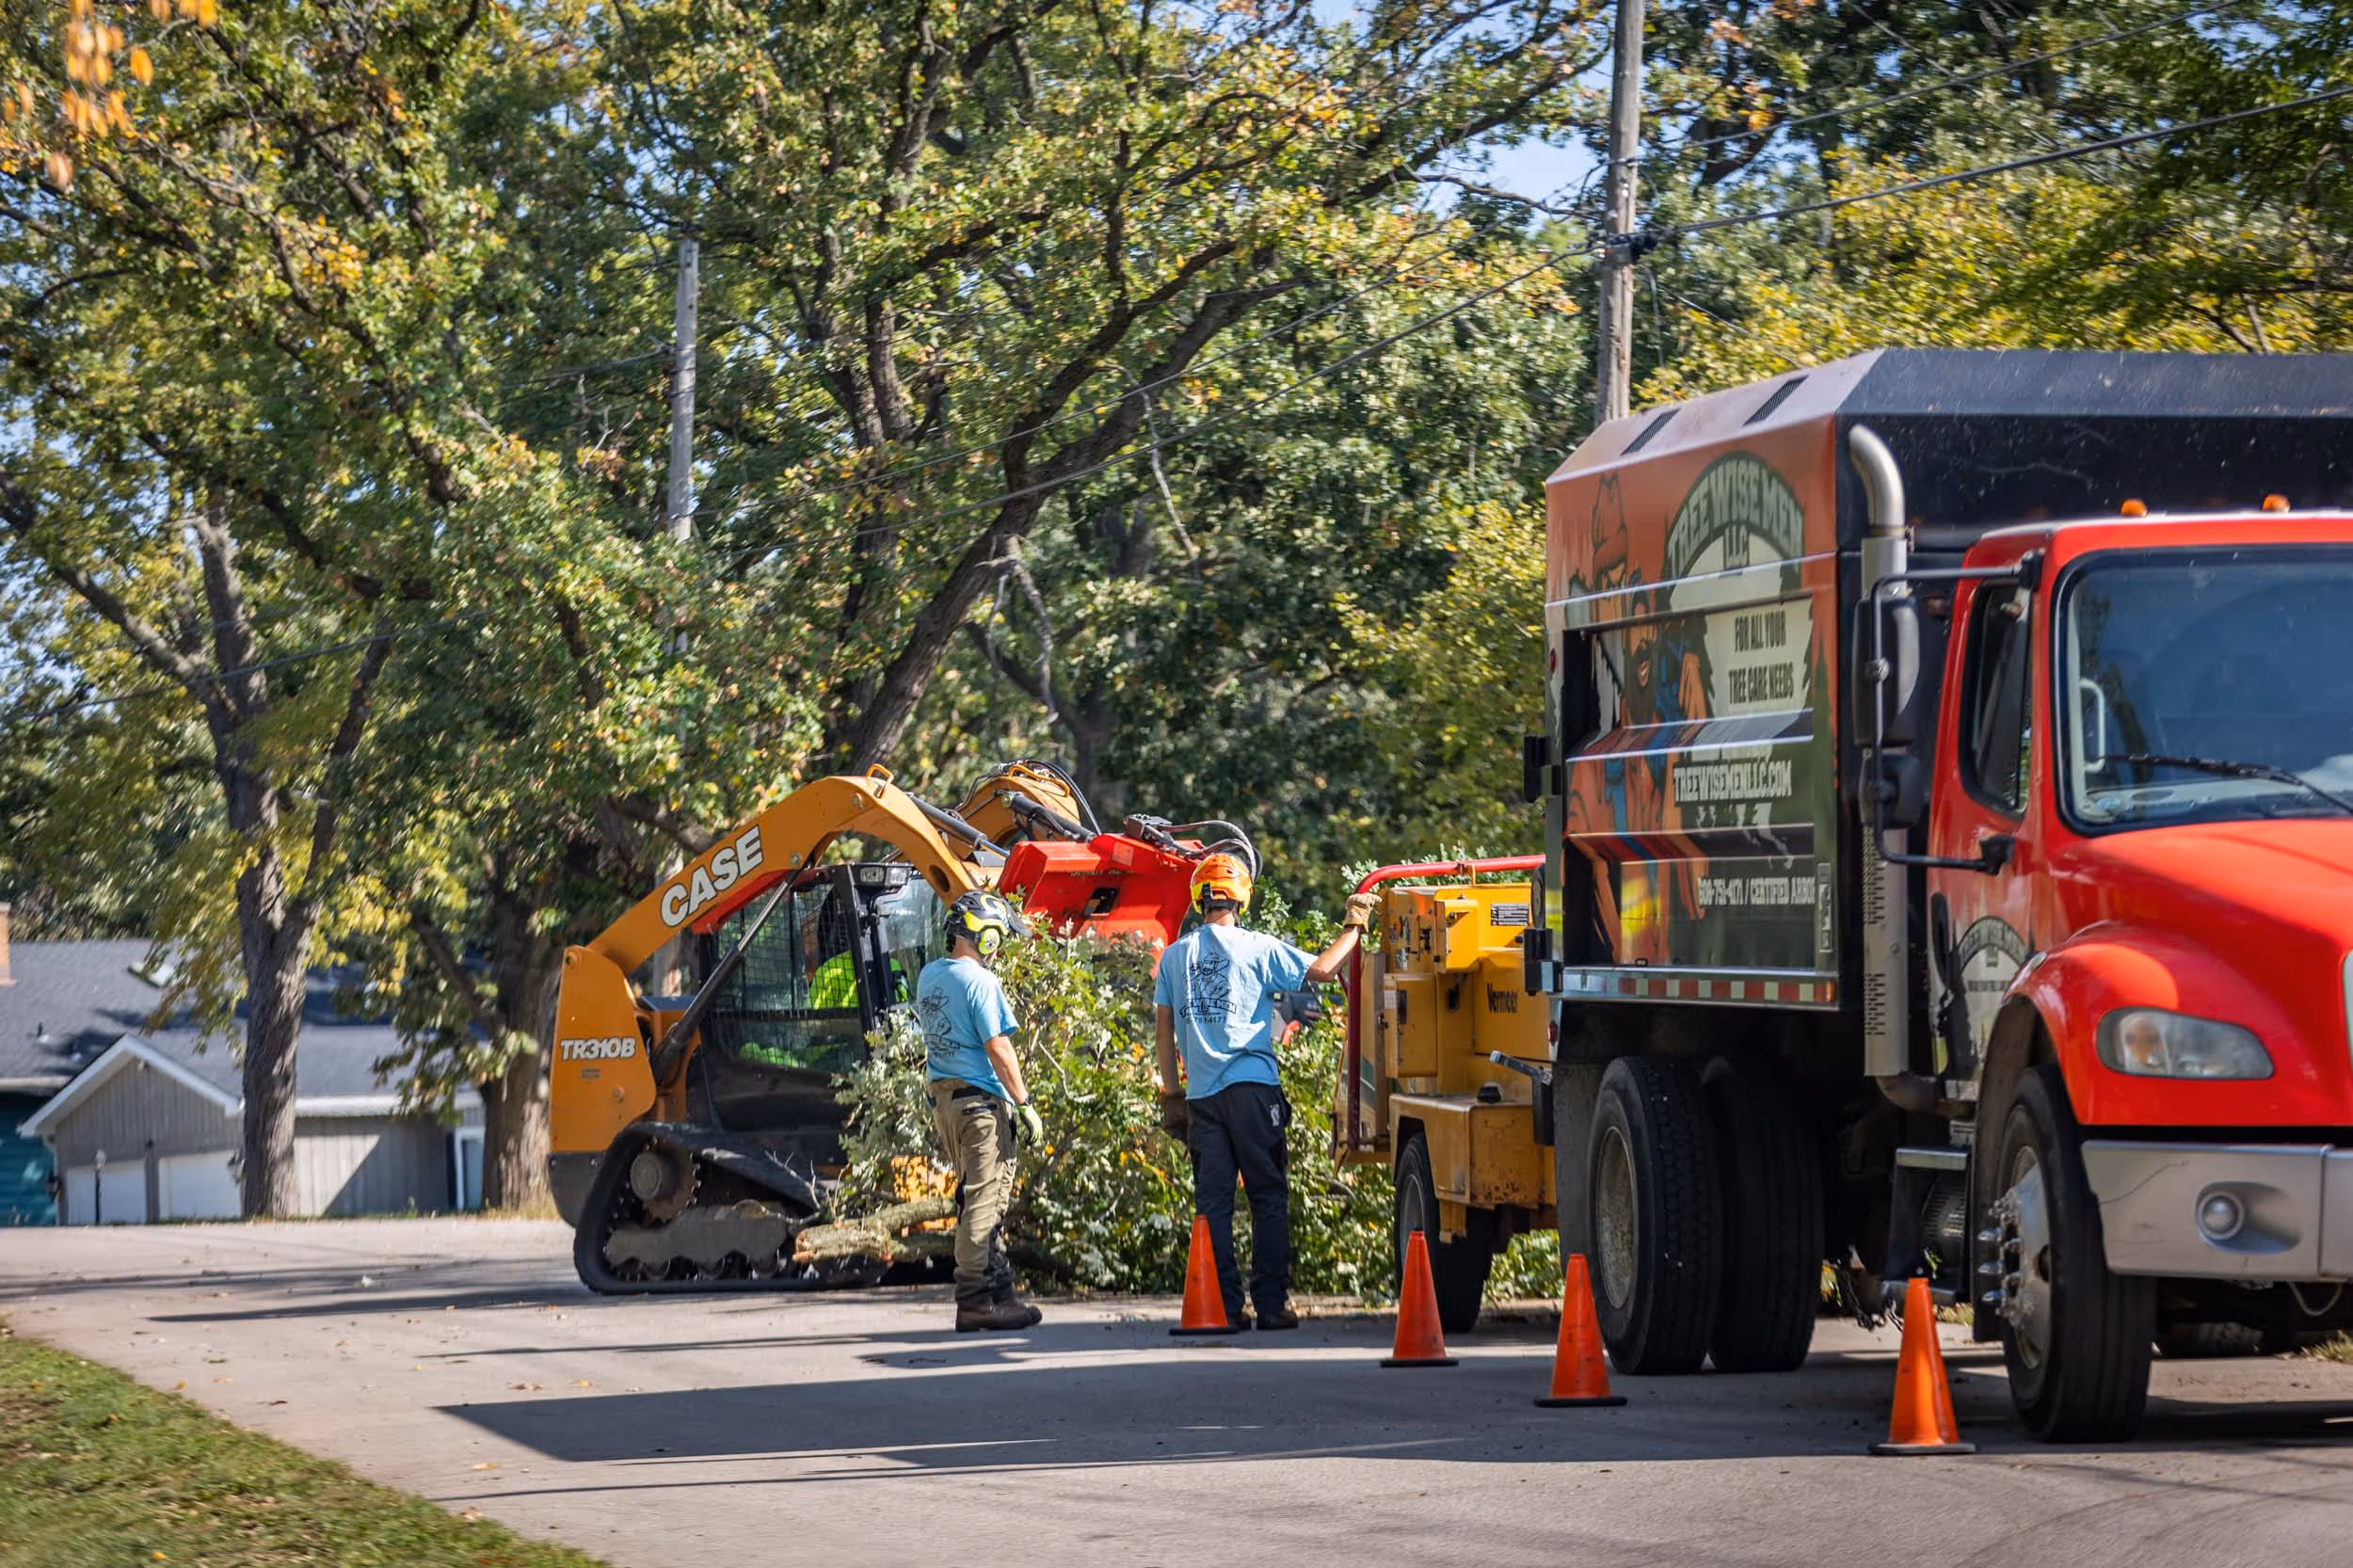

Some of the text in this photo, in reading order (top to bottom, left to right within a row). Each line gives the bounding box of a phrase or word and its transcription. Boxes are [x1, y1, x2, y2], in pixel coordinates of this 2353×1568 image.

[1668, 458, 1804, 578] TREE WISE MEN
[1724, 524, 1749, 568] LLC
[1735, 610, 1786, 652] FOR ALL YOUR
[1728, 661, 1794, 704] TREE CARE NEEDS
[1673, 760, 1793, 802] TREEWISEMENLLC.COM
[661, 824, 764, 928] CASE
[1750, 876, 1790, 905] CERTIFIED
[559, 1037, 637, 1062] TR310B
